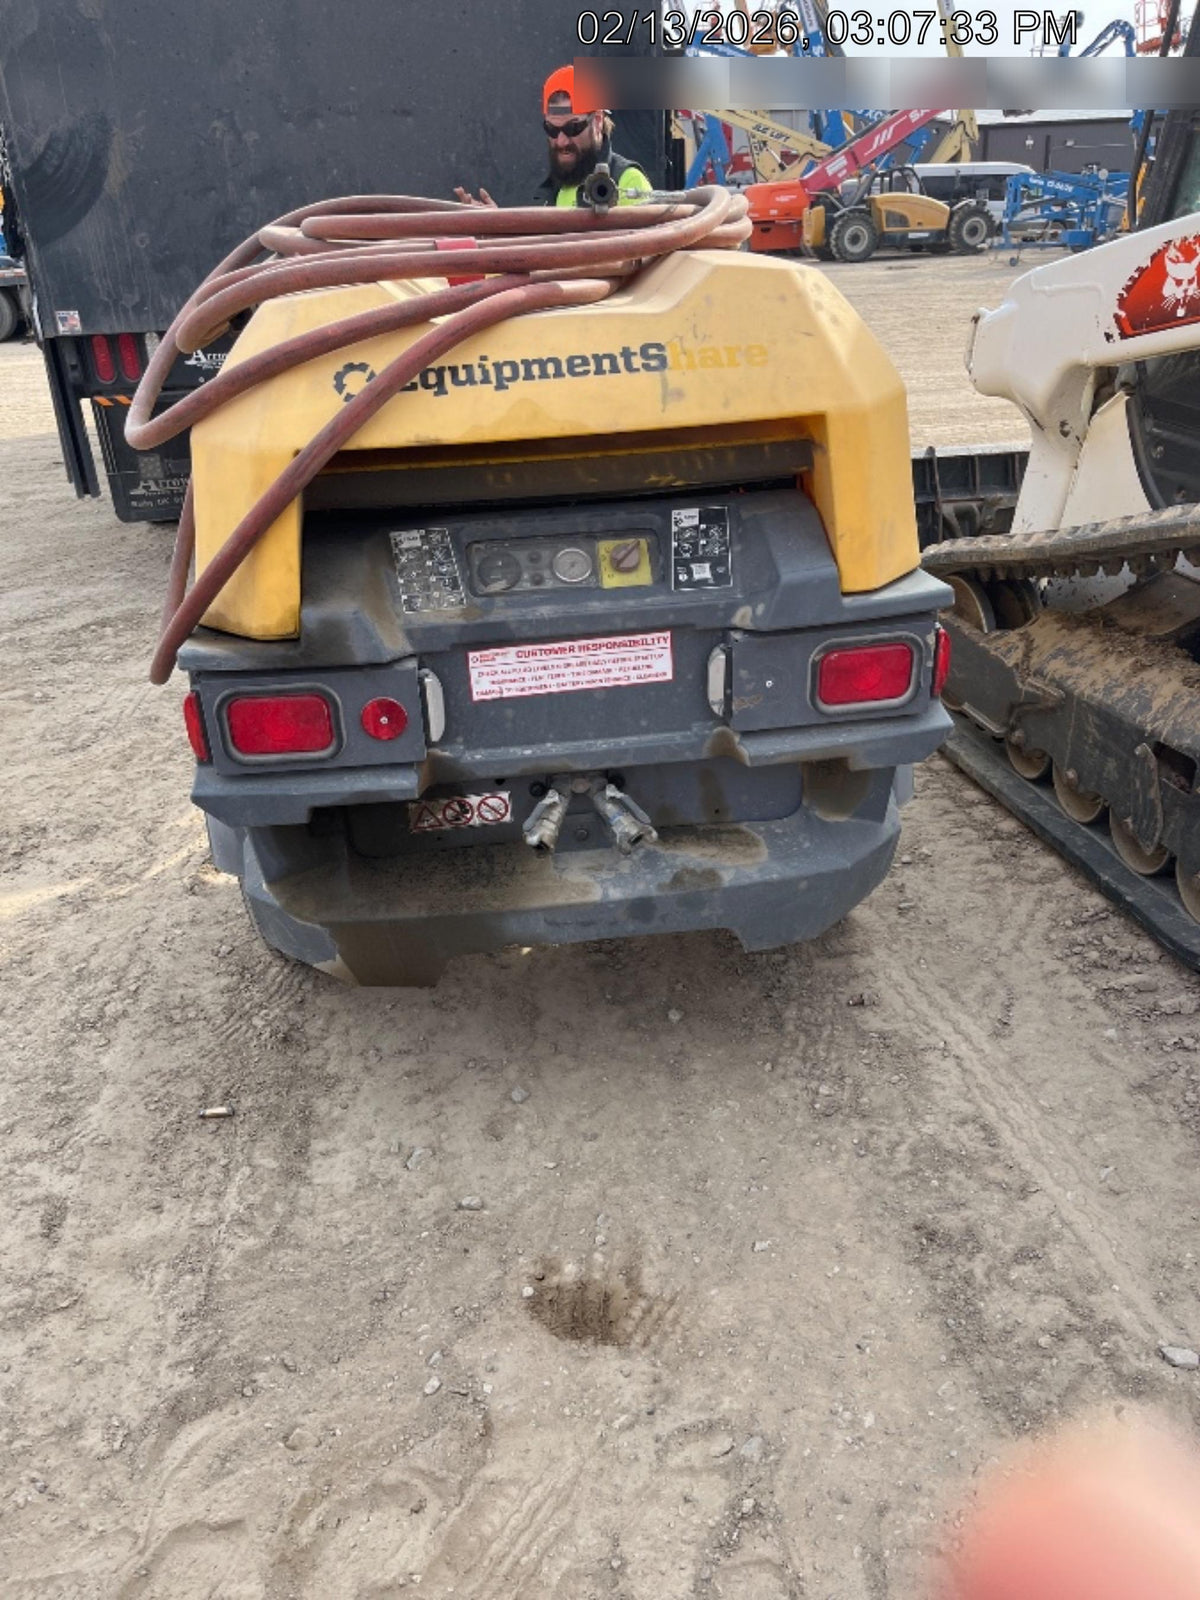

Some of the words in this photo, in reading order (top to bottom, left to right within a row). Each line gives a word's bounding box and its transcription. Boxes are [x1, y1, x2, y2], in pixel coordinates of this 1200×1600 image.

[400, 342, 768, 397] quipmentShare
[516, 646, 575, 659] CUSTOMER
[578, 636, 669, 653] RESPONSIBILITY
